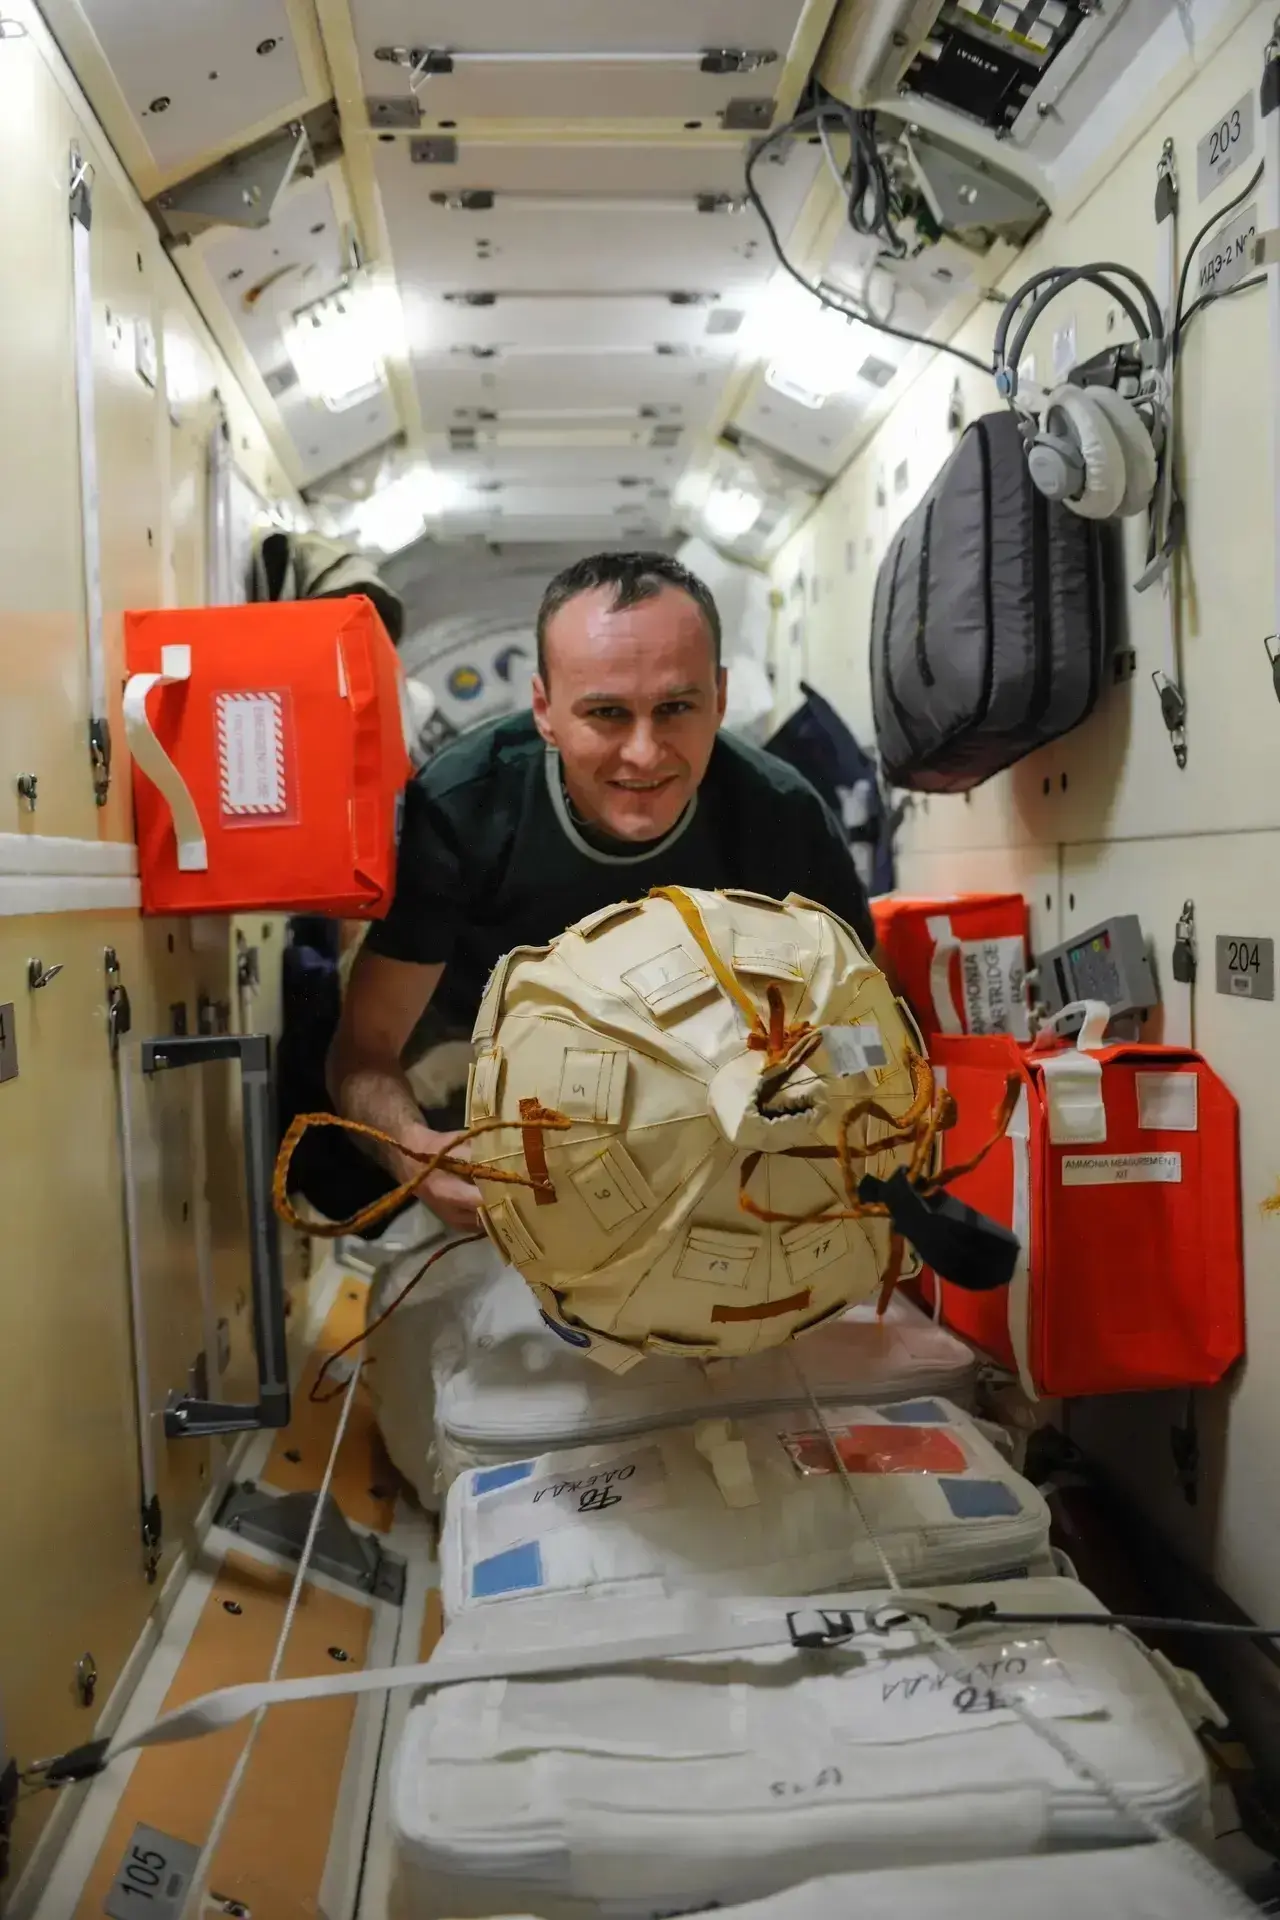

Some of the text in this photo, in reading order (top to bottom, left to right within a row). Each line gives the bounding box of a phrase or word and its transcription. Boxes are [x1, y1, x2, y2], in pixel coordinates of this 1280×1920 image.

[1209, 110, 1242, 165] 203
[1199, 245, 1233, 288] ИДЭ-2
[1228, 941, 1261, 973] 204
[964, 953, 984, 1035] AMMONIA
[983, 943, 1005, 1035] ARTRIDGE
[1065, 1156, 1178, 1170] AMMONIA MEASUREMENT
[1116, 1169, 1130, 1181] KIT
[120, 1844, 168, 1901] 105
